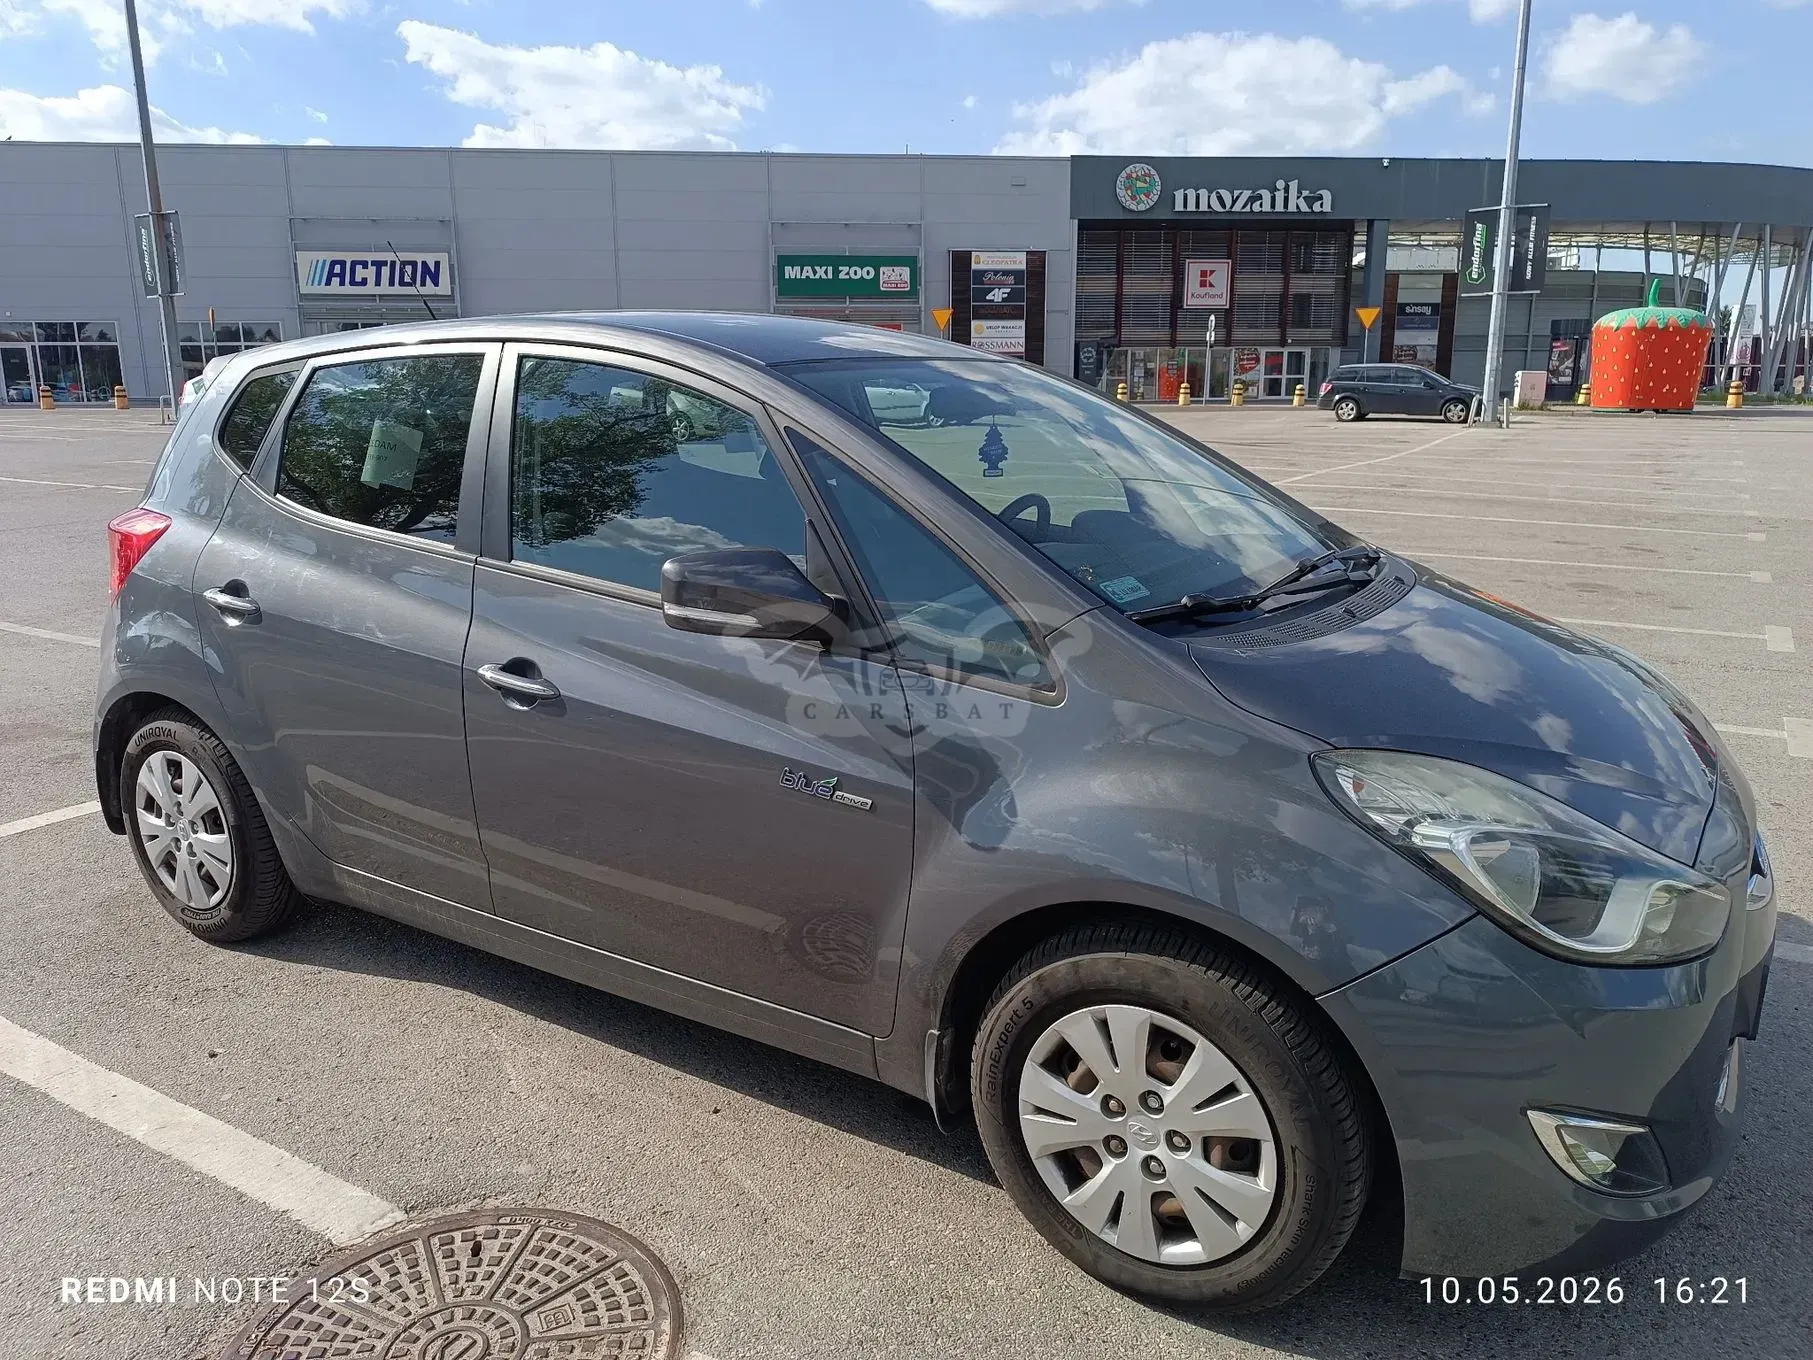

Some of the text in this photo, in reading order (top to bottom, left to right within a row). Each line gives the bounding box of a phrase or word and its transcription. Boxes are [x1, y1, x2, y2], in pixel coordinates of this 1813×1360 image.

[1173, 179, 1333, 212] mozaika
[325, 259, 441, 288] ACTION
[784, 266, 875, 279] MAXI ZOO
[985, 288, 1011, 302] 4F
[1190, 291, 1224, 299] Kaufland
[1405, 304, 1432, 315] sinsay
[134, 726, 179, 747] UNIROYAL
[780, 766, 870, 808] blue drive
[179, 916, 229, 934] UNIROYAL
[985, 995, 1035, 1103] RainExpert 5
[1236, 1173, 1316, 1291] Shark Skin Technology
